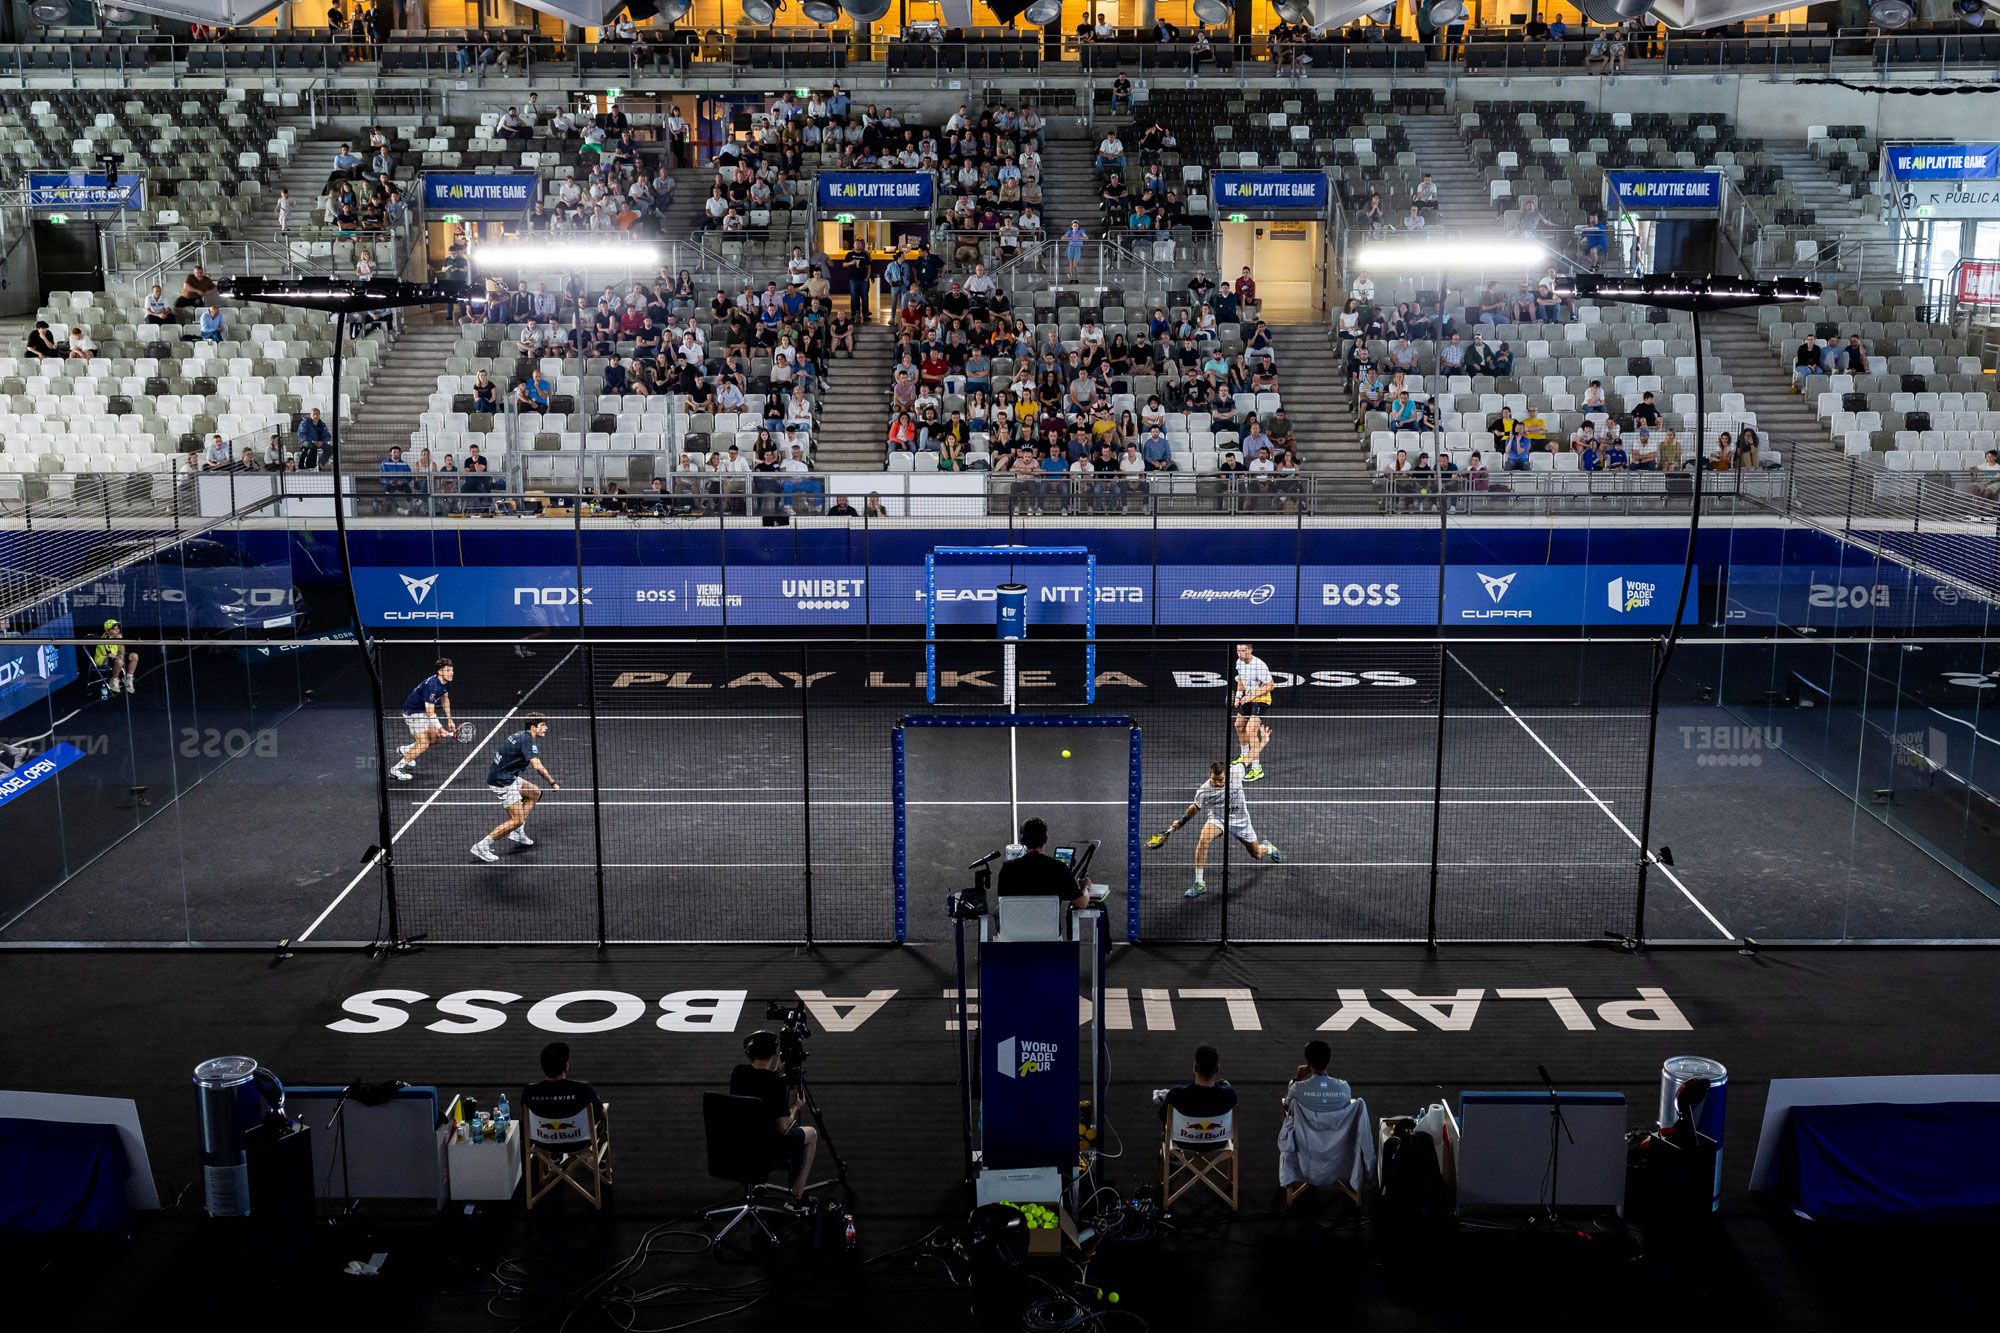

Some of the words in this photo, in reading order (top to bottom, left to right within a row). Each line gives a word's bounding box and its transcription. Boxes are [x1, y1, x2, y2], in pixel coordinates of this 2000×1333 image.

[1899, 157, 1912, 169] WE
[1926, 156, 1947, 169] PLAY
[1948, 156, 1962, 168] THE
[1964, 156, 1986, 168] GAME
[436, 186, 448, 198] WE
[464, 186, 486, 198] PLAY
[486, 186, 501, 198] THE
[502, 186, 526, 198] GAME
[830, 184, 842, 196] WE
[858, 184, 879, 196] PLAY
[880, 184, 895, 196] THE
[896, 184, 920, 196] GAME
[1225, 184, 1237, 196] WE
[1253, 184, 1274, 196] PLAY
[1274, 184, 1290, 196] THE
[1292, 184, 1315, 196] GAME
[1620, 183, 1632, 196] WE
[1648, 183, 1669, 196] PLAY
[1670, 183, 1685, 196] THE
[1686, 183, 1710, 196] GAME
[1945, 192, 1989, 204] PUBLIC
[782, 580, 864, 598] UNIBET
[1626, 580, 1656, 592] WORLD
[636, 590, 676, 602] BOSS
[1041, 587, 1084, 602] NTT
[1323, 584, 1400, 606] BOSS
[1627, 590, 1654, 599] PADEL
[384, 612, 454, 620] CUPRA
[611, 672, 836, 688] PLAY
[1084, 671, 1148, 688] A
[24, 758, 56, 780] OPEN
[325, 990, 748, 1034] BOSS
[795, 990, 899, 1032] A
[1316, 988, 1694, 1032] PLAY
[1021, 1040, 1058, 1052] WORLD
[1022, 1052, 1056, 1062] PADEL
[536, 1128, 558, 1140] Red
[559, 1128, 582, 1138] Bull
[1180, 1128, 1204, 1140] Red
[1204, 1128, 1226, 1140] Bull
